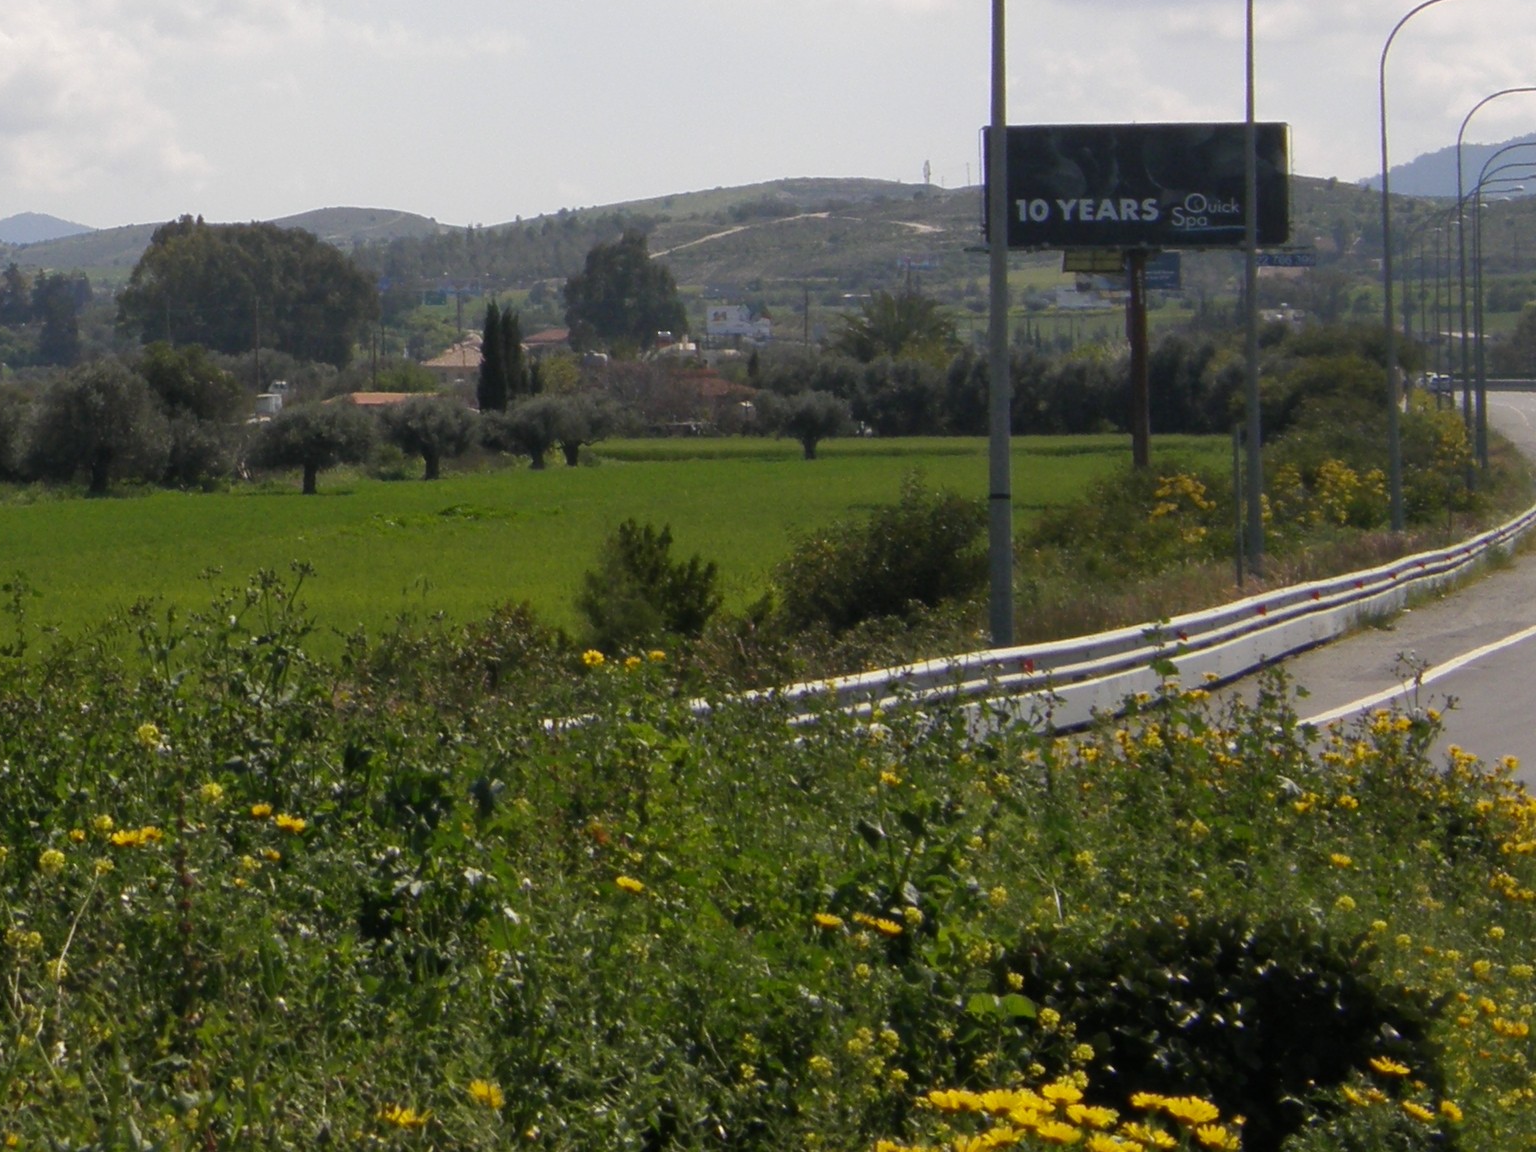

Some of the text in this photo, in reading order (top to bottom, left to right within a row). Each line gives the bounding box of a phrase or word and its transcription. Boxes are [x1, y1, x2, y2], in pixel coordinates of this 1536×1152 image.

[1015, 198, 1160, 222] 10 YEARS
[1184, 193, 1240, 214] Quick
[1171, 206, 1208, 229] Spa
